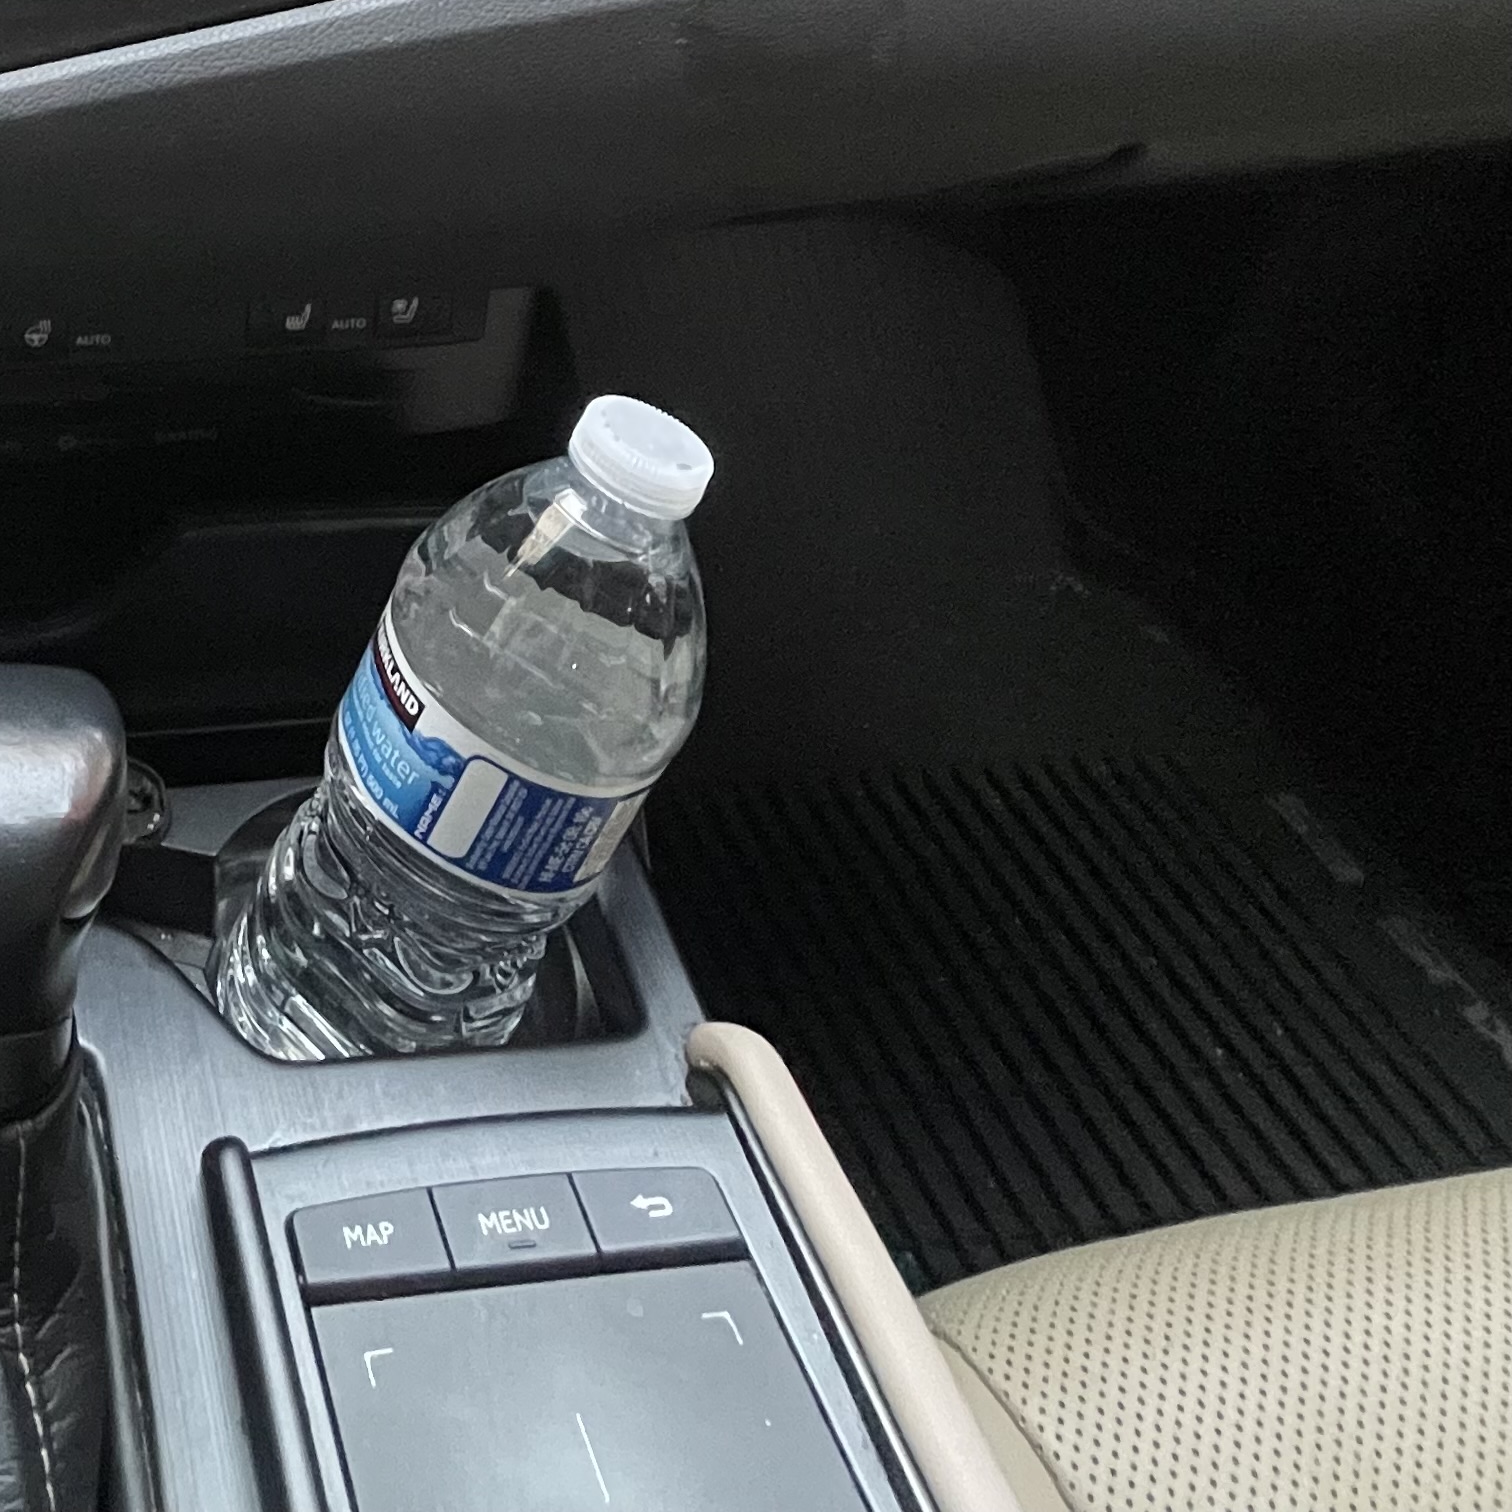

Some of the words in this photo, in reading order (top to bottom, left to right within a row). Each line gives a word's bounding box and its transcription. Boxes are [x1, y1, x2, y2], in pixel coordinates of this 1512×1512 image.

[331, 317, 367, 330] AUTO
[75, 334, 111, 346] AUTO
[371, 721, 420, 785] water
[343, 1221, 394, 1249] MAP
[477, 1206, 550, 1236] MENU
